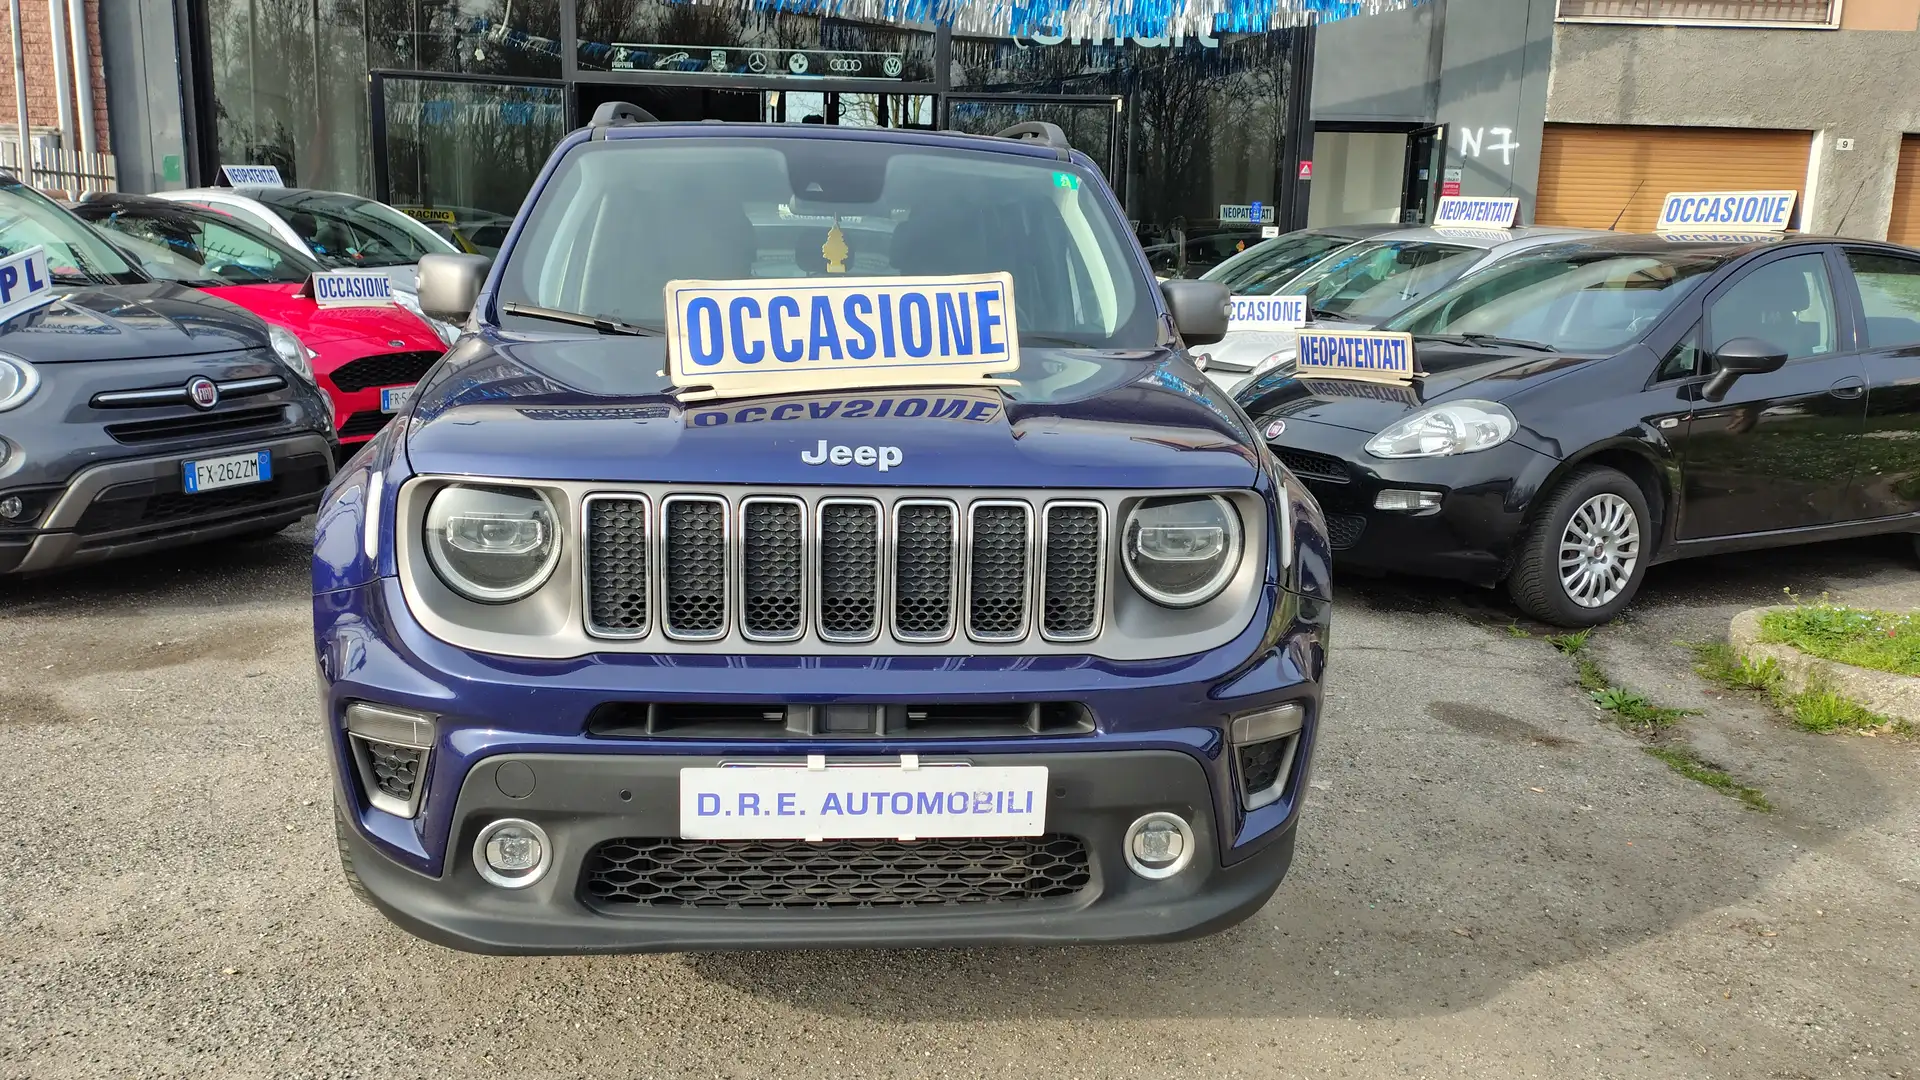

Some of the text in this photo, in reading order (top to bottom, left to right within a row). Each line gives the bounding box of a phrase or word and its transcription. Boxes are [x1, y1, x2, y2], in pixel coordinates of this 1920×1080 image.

[1461, 127, 1520, 165] N 7
[1842, 140, 1849, 149] 9
[227, 168, 280, 184] NEOPATENTATI
[408, 210, 450, 220] RACING
[1223, 207, 1272, 220] NEOPATEATI
[1440, 200, 1514, 222] NEOPATENTATI
[1665, 197, 1789, 223] OCCASIONE
[318, 277, 391, 298] OCCASIONE
[686, 289, 1005, 366] OCCASIONE
[1300, 336, 1406, 371] NEOPATENTATI
[197, 386, 213, 401] FIAT
[801, 440, 903, 472] Jeep
[697, 790, 1033, 817] D.R.E. AUTOMOBILI
